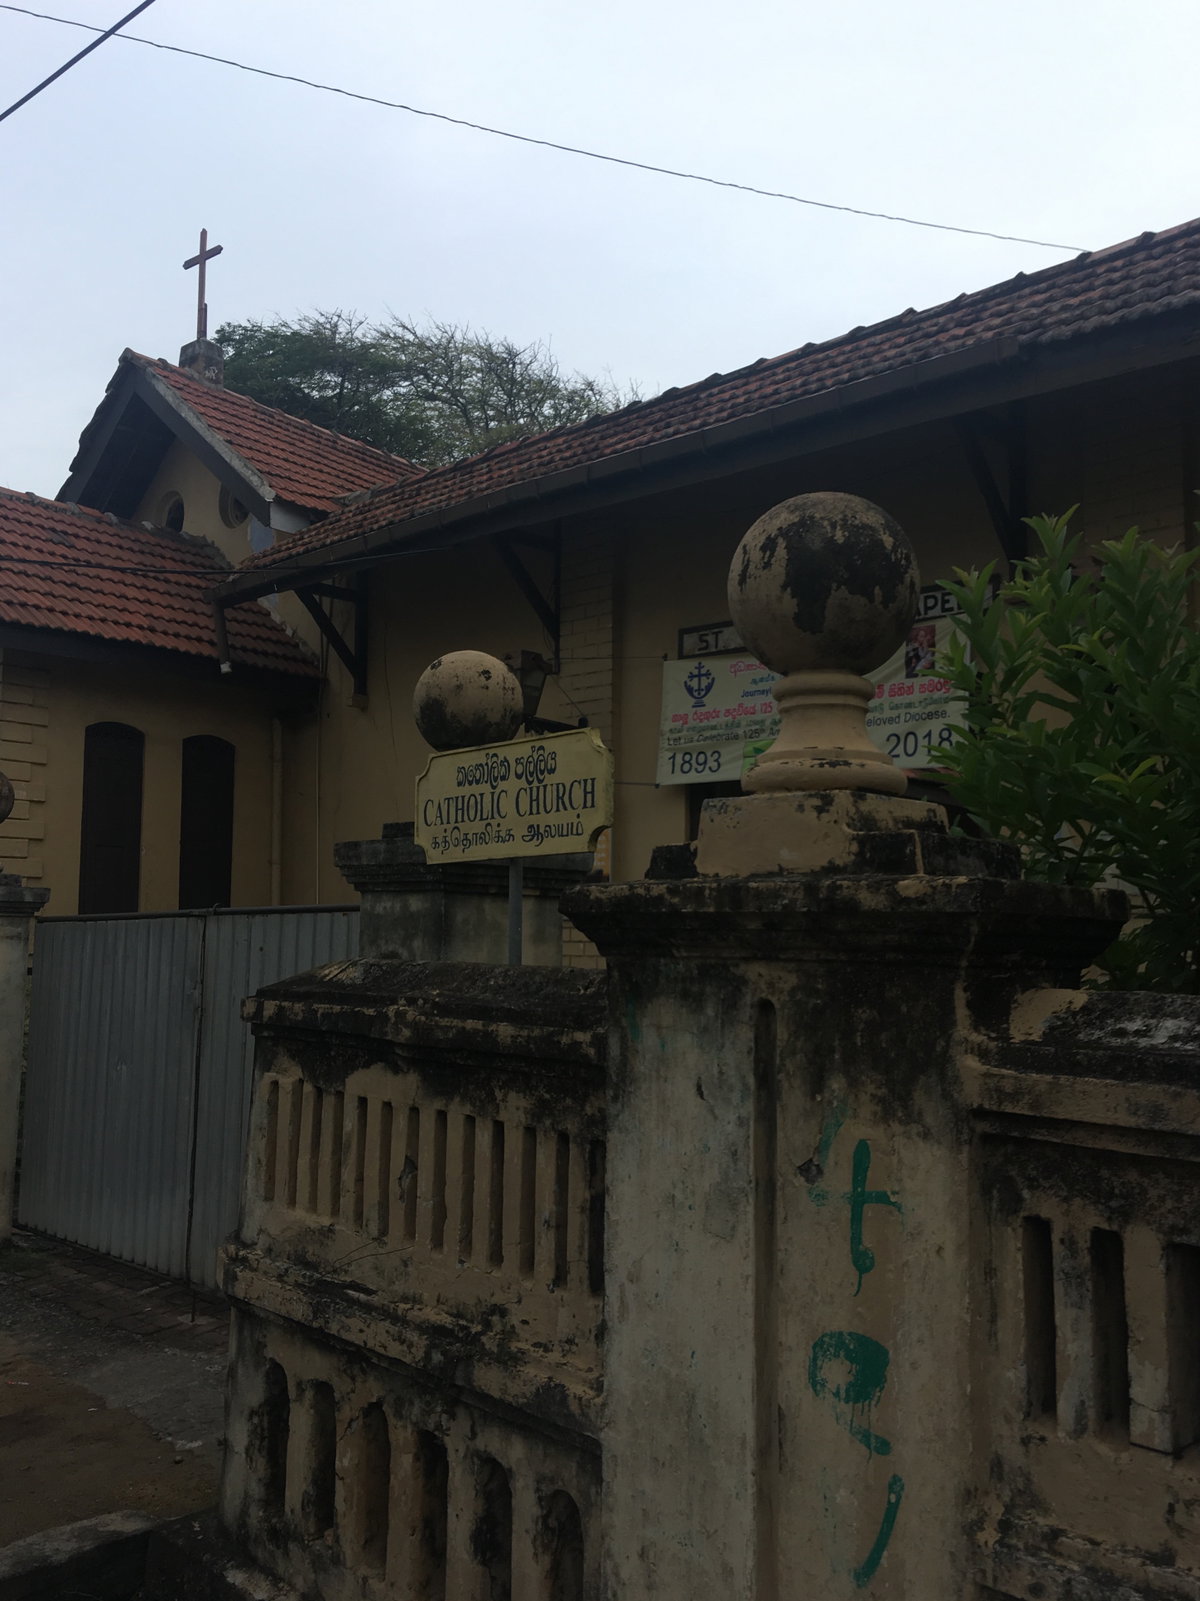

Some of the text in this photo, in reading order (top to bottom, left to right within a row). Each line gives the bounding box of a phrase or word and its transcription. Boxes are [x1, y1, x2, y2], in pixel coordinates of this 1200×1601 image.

[741, 687, 772, 699] Journeyi
[866, 708, 950, 728] eloved Diocese.
[886, 727, 954, 759] 2018
[514, 745, 558, 785] පල්ලිය
[668, 750, 722, 775] 1893
[423, 777, 597, 827] CATHOLIC CHURCH
[522, 813, 584, 847] ஆலயம்
